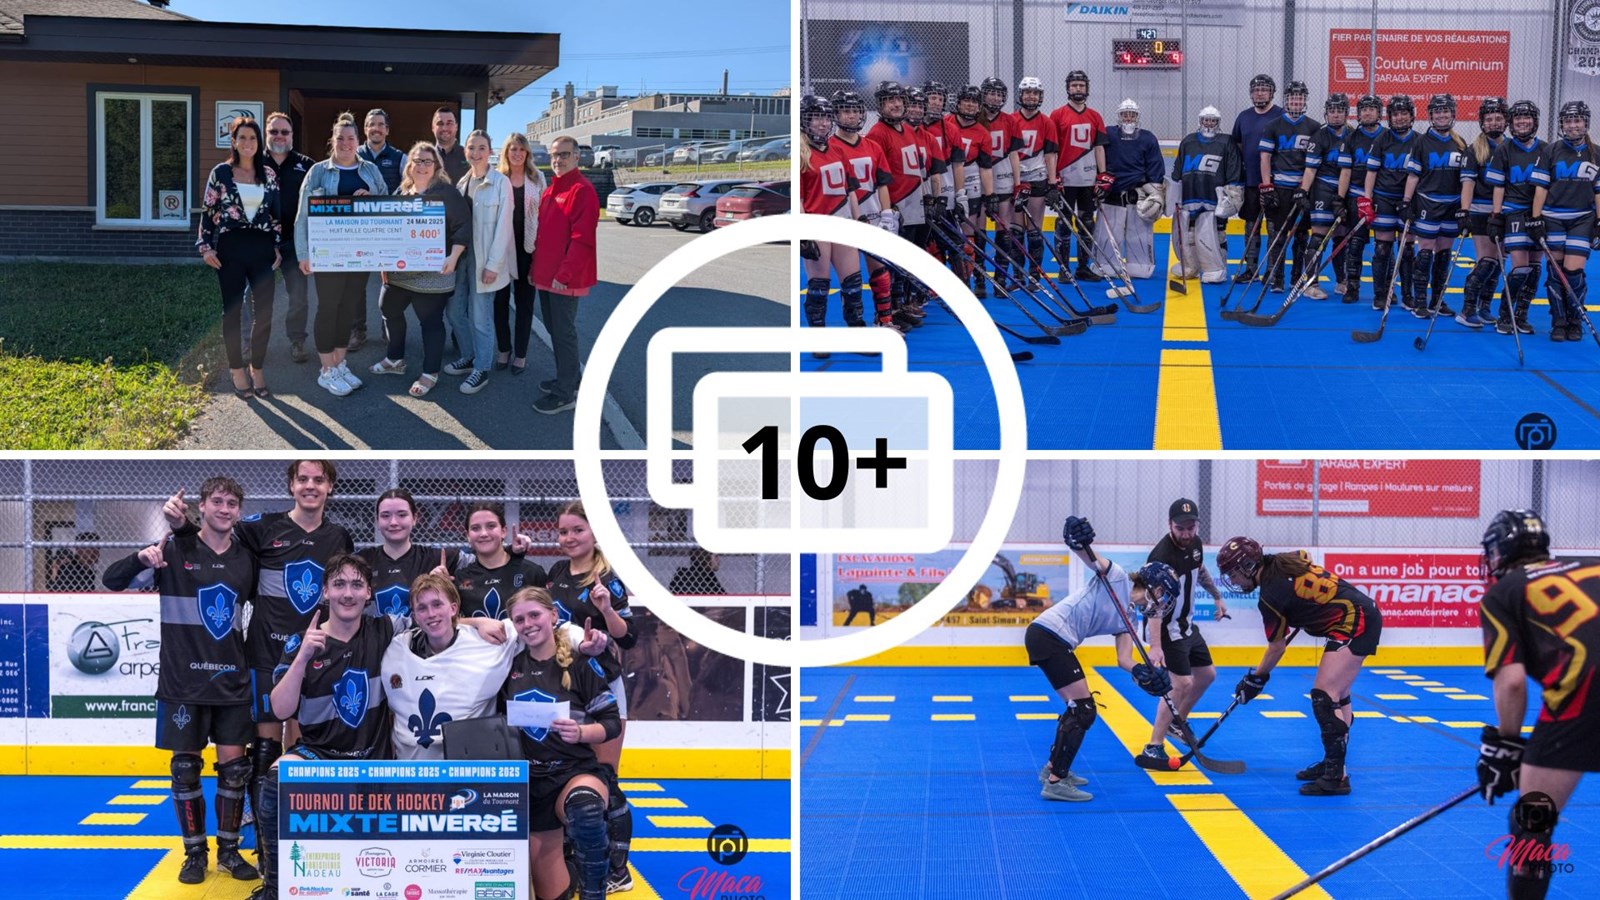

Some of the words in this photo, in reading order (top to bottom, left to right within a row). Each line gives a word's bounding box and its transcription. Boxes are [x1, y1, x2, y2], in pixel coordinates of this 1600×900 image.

[1079, 6, 1128, 15] DAIKIN
[1354, 34, 1408, 42] PARENAIRE
[1445, 33, 1507, 43] RÉALISATIONS
[1375, 57, 1427, 69] Couture
[1432, 58, 1503, 71] Aluminium
[1413, 74, 1448, 83] EXPERT
[1182, 154, 1222, 173] MG
[1555, 161, 1600, 181] MG
[310, 205, 351, 213] MIXTE
[353, 198, 423, 212] INVERSÉ
[1315, 201, 1324, 210] 22
[1511, 222, 1519, 232] 17
[410, 229, 417, 239] 8
[1264, 481, 1291, 490] Portes
[1294, 482, 1304, 490] de
[1307, 483, 1338, 492] grage
[1345, 484, 1378, 492] Rampes
[838, 567, 902, 579] Lapointe
[906, 568, 916, 577] &
[921, 568, 945, 577] Fils
[1334, 564, 1354, 576] On
[1358, 566, 1367, 576] a
[1372, 566, 1398, 576] une
[1402, 564, 1424, 578] job
[1429, 566, 1461, 578] pour
[190, 662, 236, 671] QUÉBECOR
[85, 700, 158, 712] www.franc
[288, 767, 336, 777] CHAMPIONS
[337, 767, 359, 777] 2025
[368, 767, 416, 777] CHAMPIONS
[418, 767, 440, 777] 2025
[448, 767, 497, 777] CHAMPIONS
[498, 767, 520, 777] 2025
[289, 794, 344, 810] TOURNOI
[349, 794, 364, 810] DE
[368, 794, 392, 810] DEK
[396, 794, 445, 810] HOCKEY
[289, 813, 397, 832] MIXTE
[401, 809, 518, 832] INVERSÉ
[355, 857, 395, 868] VICTORIA
[405, 865, 447, 873] CORMIER
